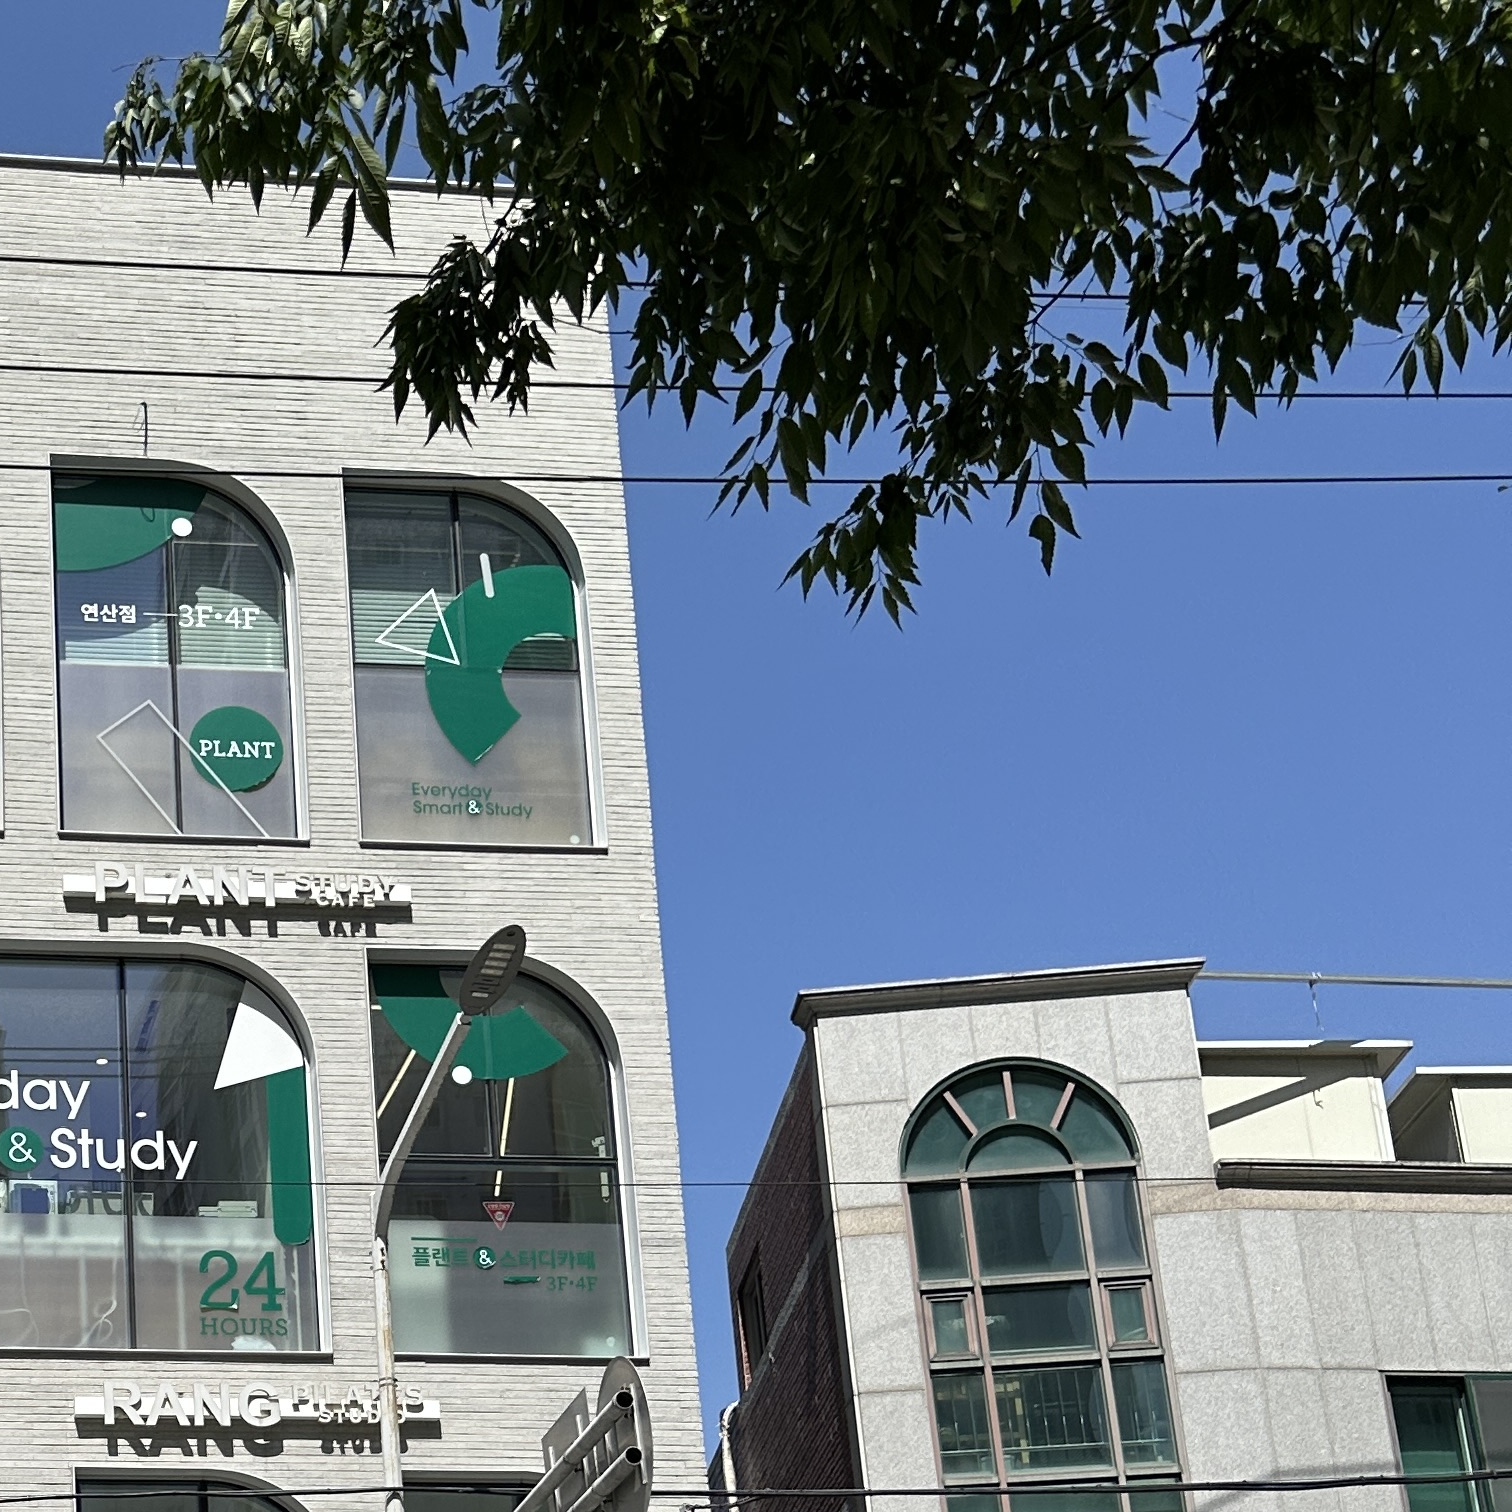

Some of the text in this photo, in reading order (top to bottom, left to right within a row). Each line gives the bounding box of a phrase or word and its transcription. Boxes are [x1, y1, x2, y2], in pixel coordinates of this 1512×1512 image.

[81, 603, 137, 624] 연산점
[199, 739, 276, 759] PLANT
[411, 782, 492, 806] Everyday
[413, 799, 533, 820] Smart & Study
[94, 860, 286, 907] PLANT
[295, 873, 397, 897] STUDY
[315, 892, 376, 909] CAFE
[7, 1131, 37, 1164] &
[49, 1126, 198, 1180] Study
[411, 1246, 469, 1268] 플랜트
[499, 1247, 597, 1271] 스터디카페
[199, 1249, 287, 1312] 24
[199, 1316, 289, 1338] HOURS
[102, 1381, 282, 1427] RANG
[292, 1383, 424, 1406] PILATS
[318, 1408, 406, 1424] STUDO
